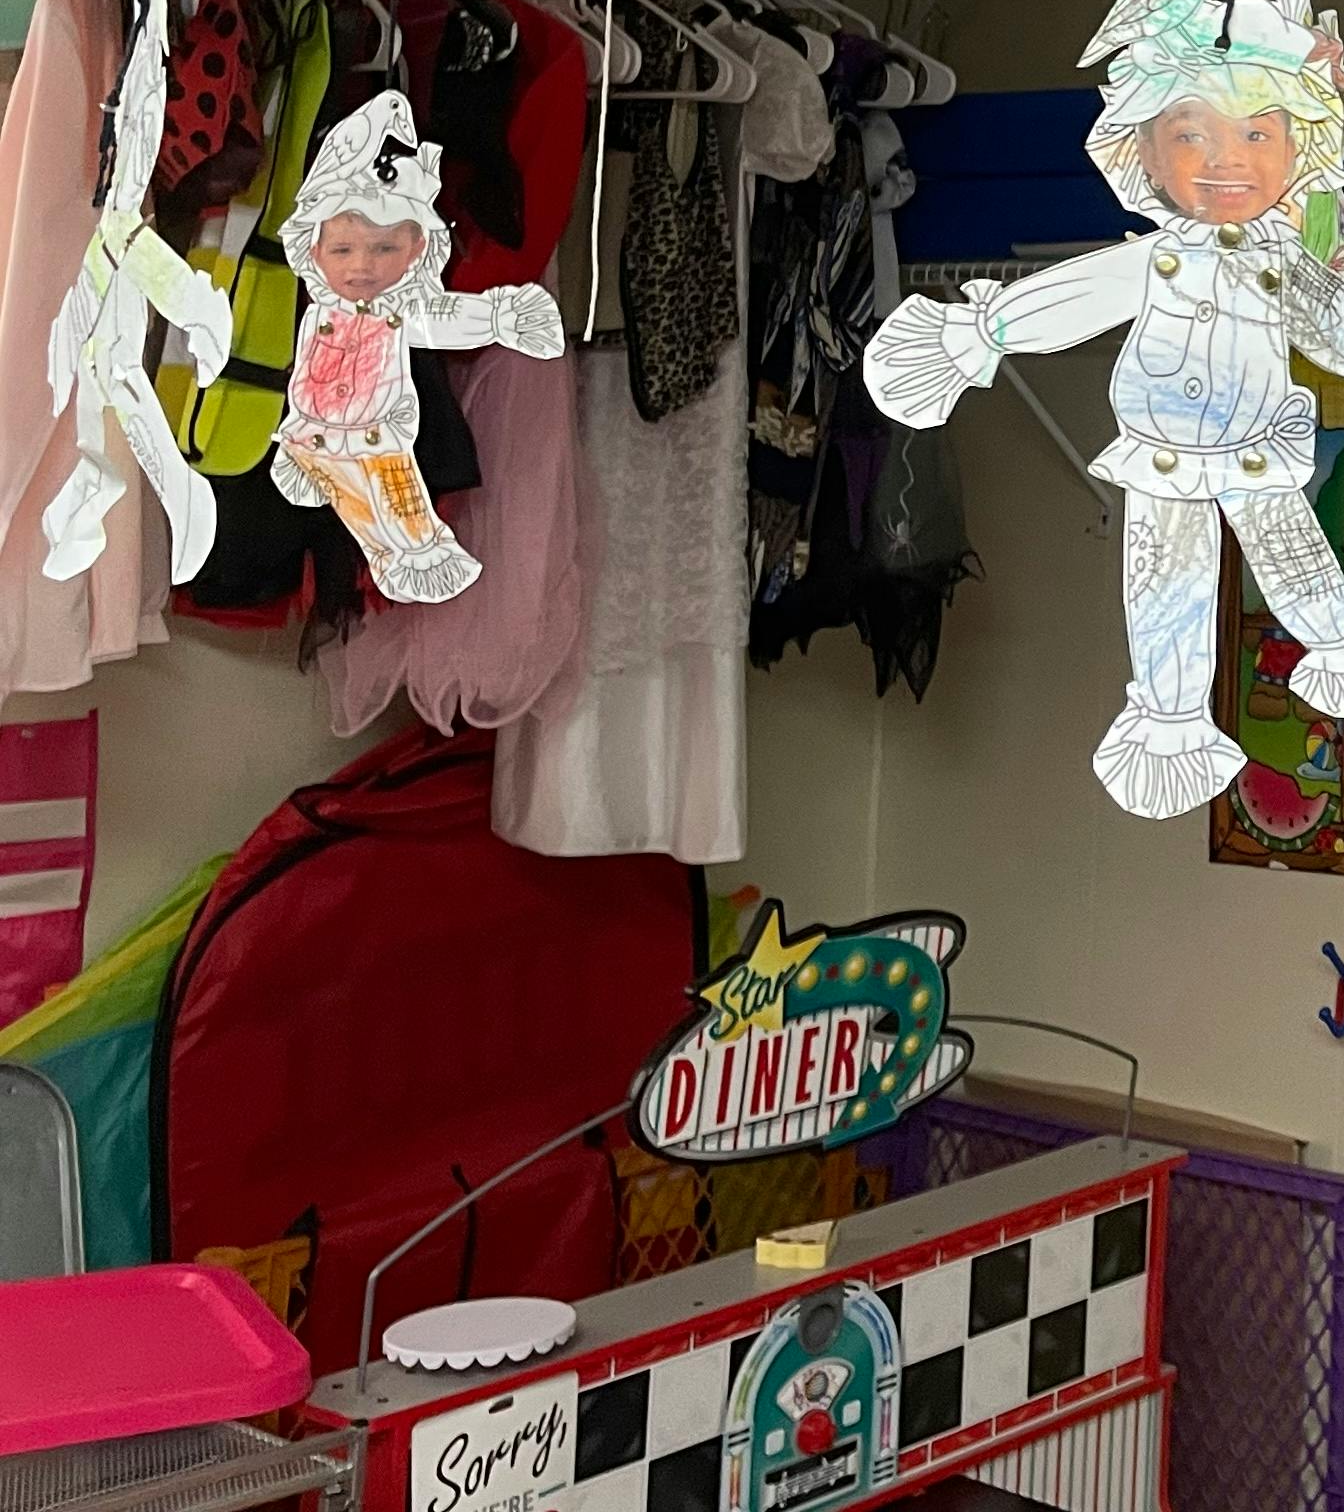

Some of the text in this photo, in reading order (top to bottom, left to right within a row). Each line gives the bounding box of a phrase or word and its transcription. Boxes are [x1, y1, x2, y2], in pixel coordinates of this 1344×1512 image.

[709, 962, 800, 1040] Star
[664, 1019, 859, 1139] DINER
[427, 1402, 567, 1512] Sorry,
